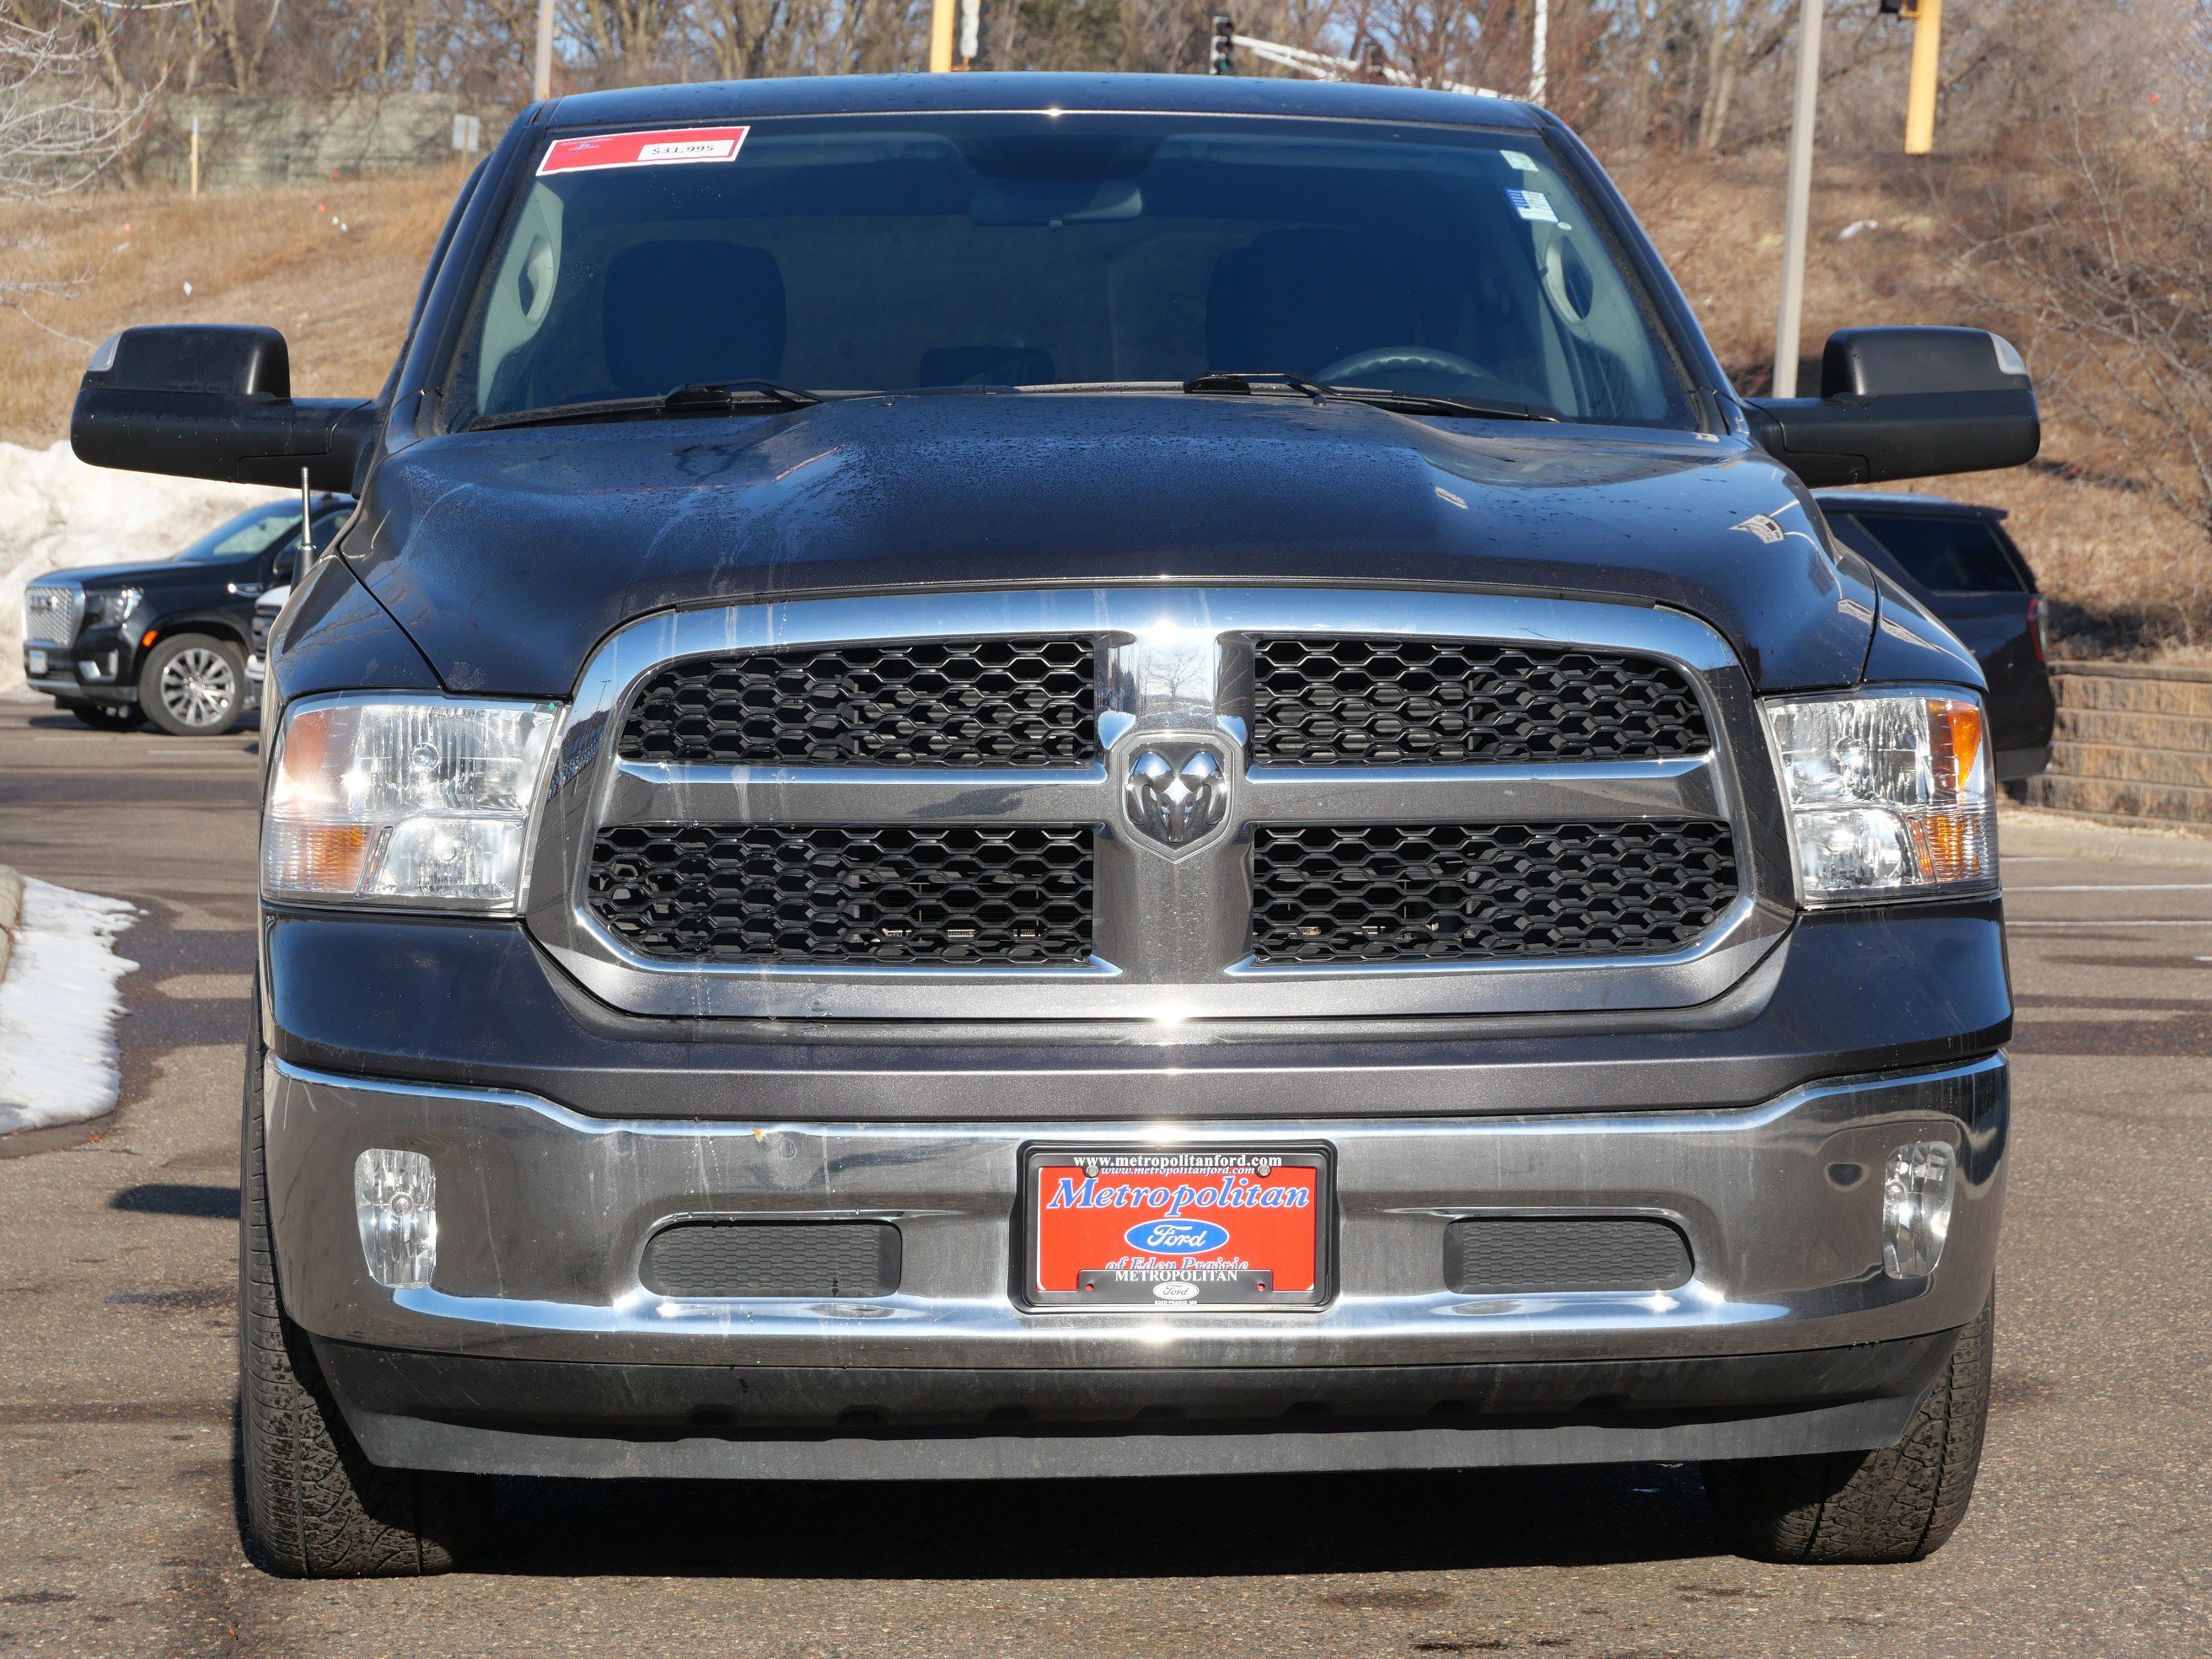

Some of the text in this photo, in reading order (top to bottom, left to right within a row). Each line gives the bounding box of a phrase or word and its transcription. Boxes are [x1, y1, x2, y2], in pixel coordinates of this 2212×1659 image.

[652, 144, 715, 155] $31,995
[1073, 1154, 1283, 1169] www.metropolitanford.com
[1101, 1166, 1255, 1177] www.metropolitanford.com
[1046, 1175, 1310, 1216] Metropolitan
[1146, 1225, 1206, 1247] Ford
[1105, 1256, 1249, 1270] of Eden Prairie
[1114, 1270, 1238, 1281] METROPOLITAN
[1163, 1284, 1189, 1296] Ford
